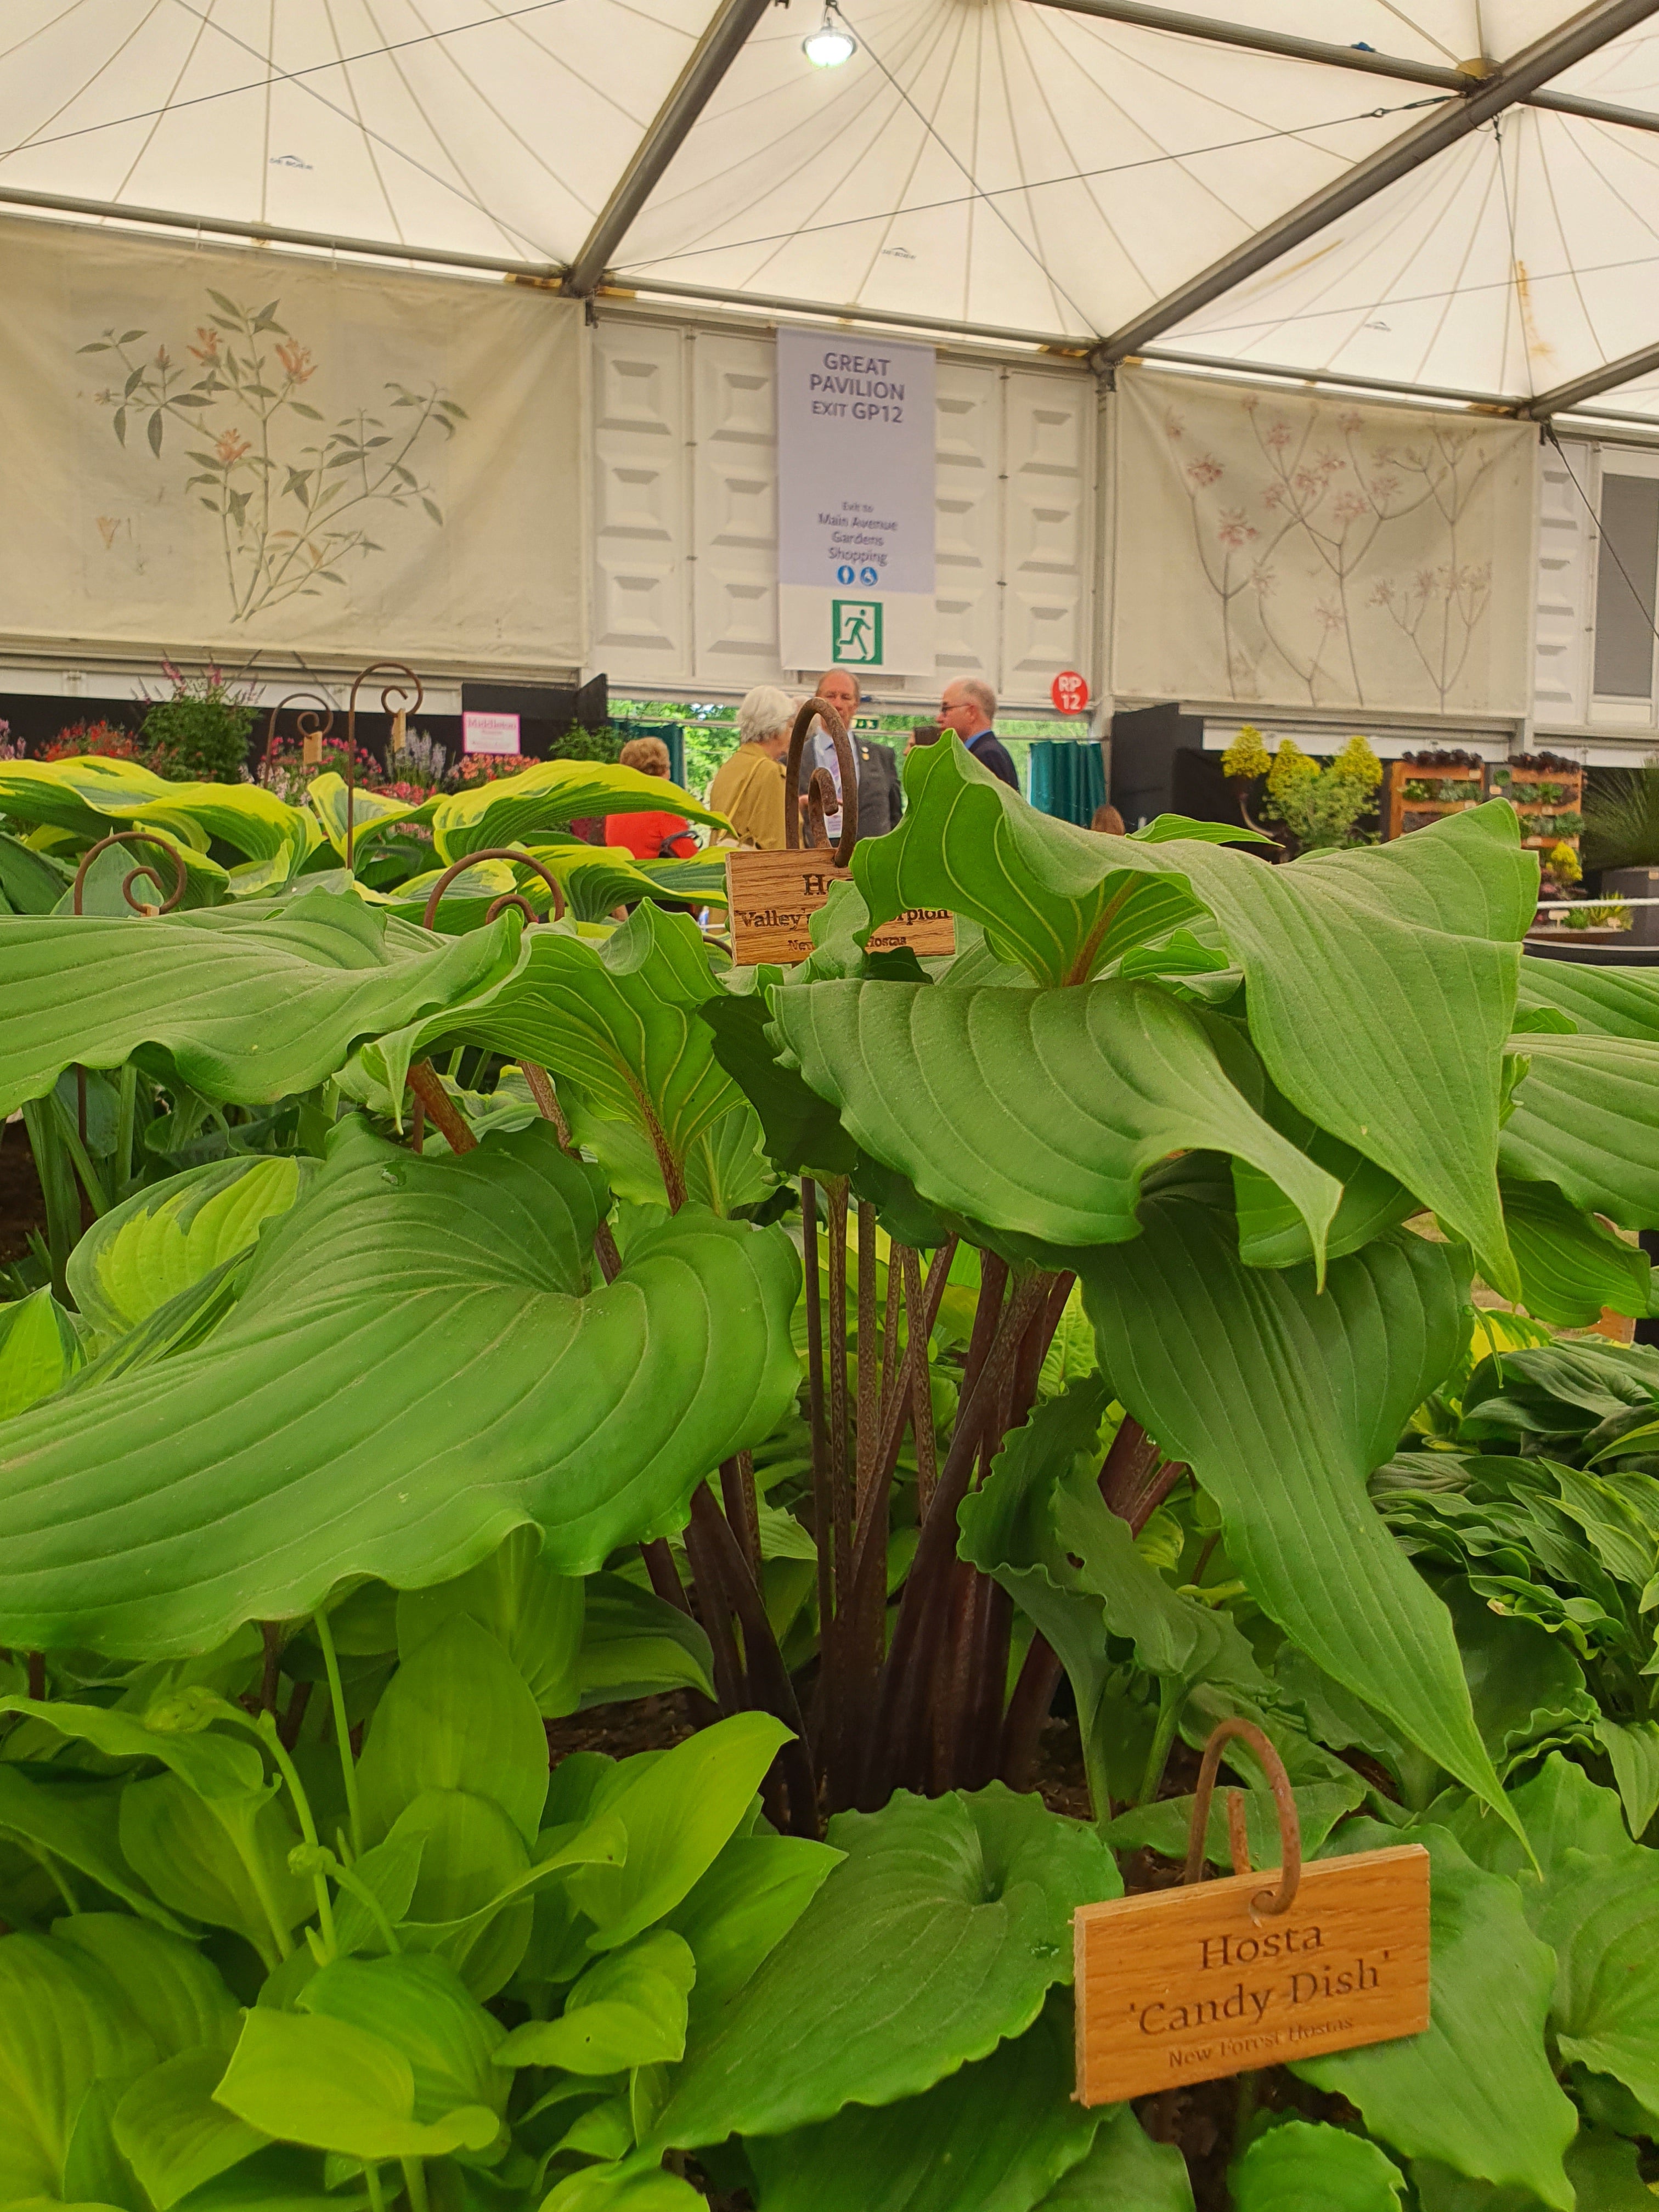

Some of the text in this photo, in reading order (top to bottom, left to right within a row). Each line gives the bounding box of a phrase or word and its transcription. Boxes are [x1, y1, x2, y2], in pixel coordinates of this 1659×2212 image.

[825, 352, 891, 376] GREAT
[809, 374, 905, 400] PAVILION
[812, 400, 902, 423] EXIT GP12
[842, 501, 860, 511] Exit
[818, 513, 898, 531] Main Avenue
[832, 531, 884, 546] Gardens
[828, 548, 888, 567] Shopping
[1058, 676, 1082, 692] RP
[1060, 693, 1082, 710] 12
[889, 909, 950, 926] rpion
[1198, 1925, 1325, 1971] Hosta
[1128, 1949, 1392, 2036] 'Candy Dish'
[1168, 2017, 1353, 2068] New Forest Hostas
